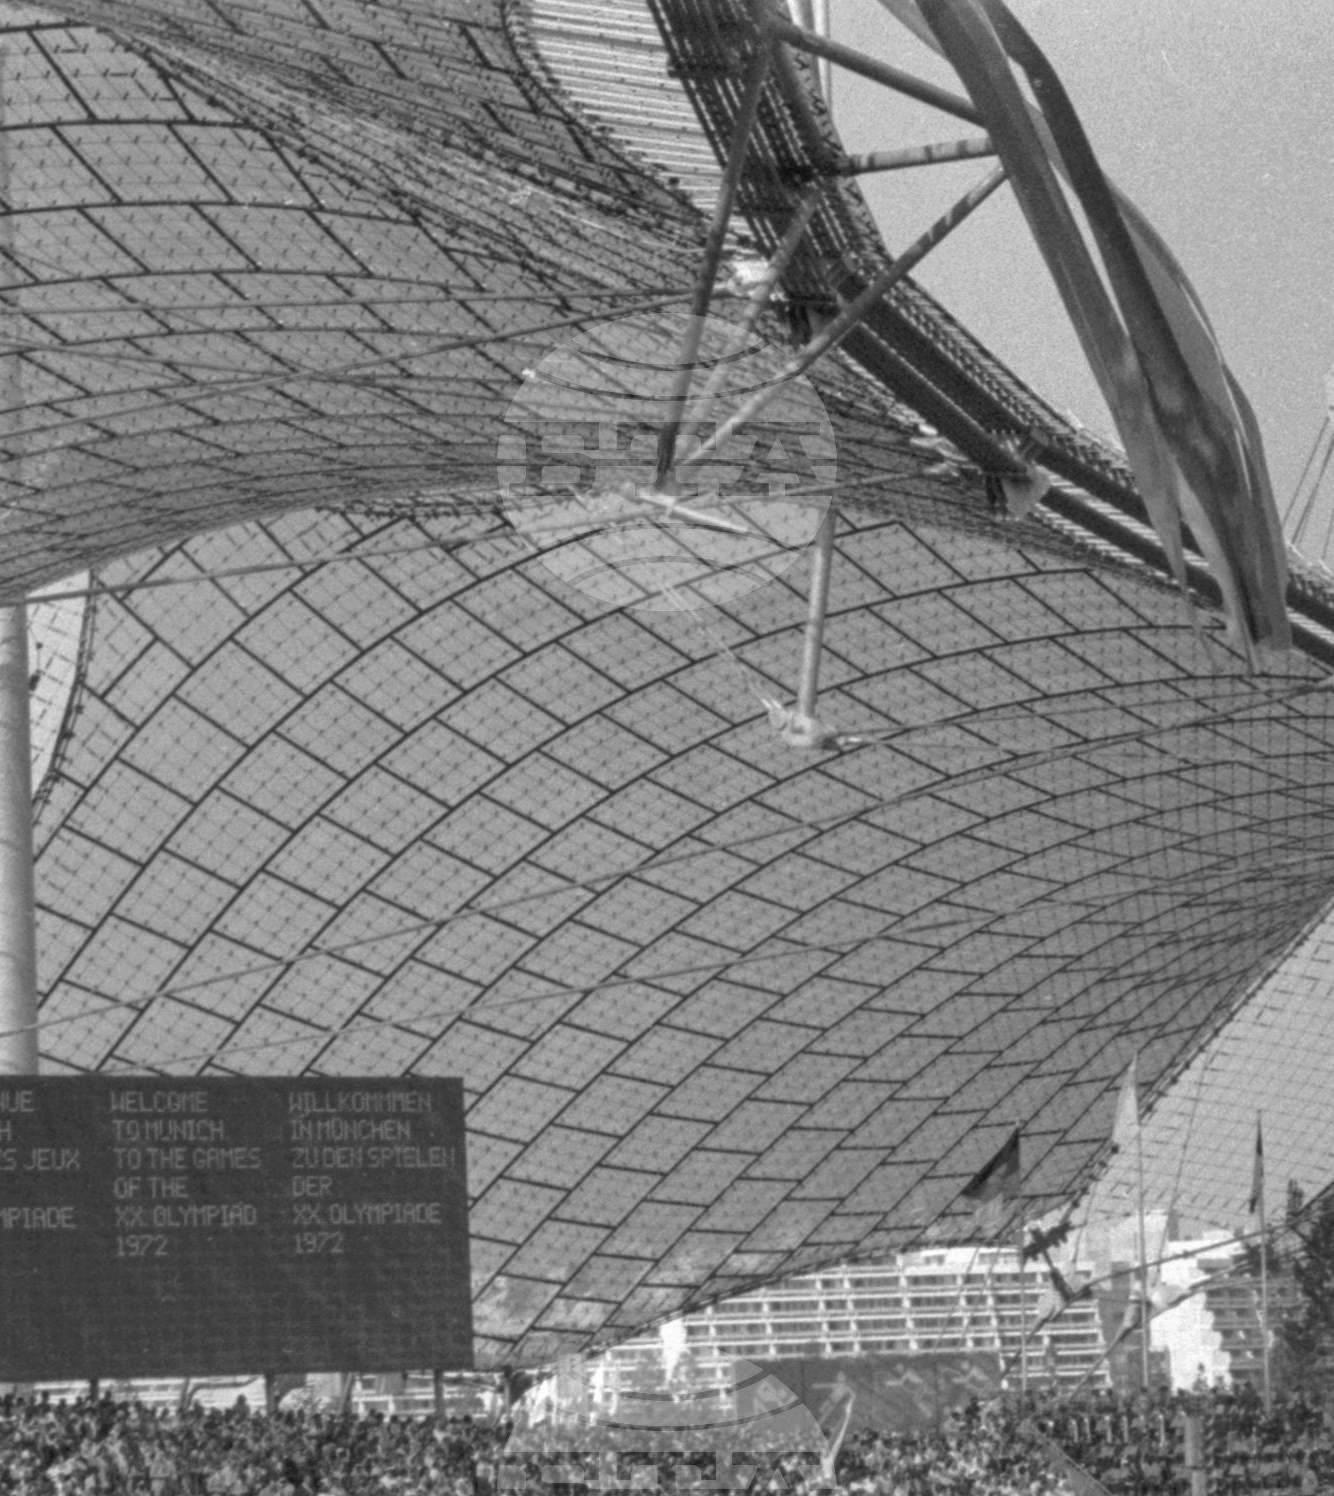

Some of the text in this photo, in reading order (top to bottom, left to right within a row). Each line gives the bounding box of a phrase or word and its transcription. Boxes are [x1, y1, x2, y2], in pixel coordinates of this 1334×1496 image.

[110, 1091, 208, 1113] WELCOME
[288, 1090, 432, 1113] WILLKOMMEN
[112, 1119, 224, 1141] TO MUNICH
[291, 1119, 313, 1141] IN
[23, 1148, 81, 1171] JEUX
[113, 1147, 262, 1170] TO THE GAMES
[290, 1145, 456, 1168] ZU DEN SPIELEN
[114, 1176, 189, 1199] OF THE
[292, 1175, 333, 1197] DER
[152, 1204, 257, 1227] OLYMPIAD
[329, 1202, 443, 1225] OLYMPIADE
[117, 1234, 168, 1257] 1972
[294, 1230, 344, 1254] 1972
